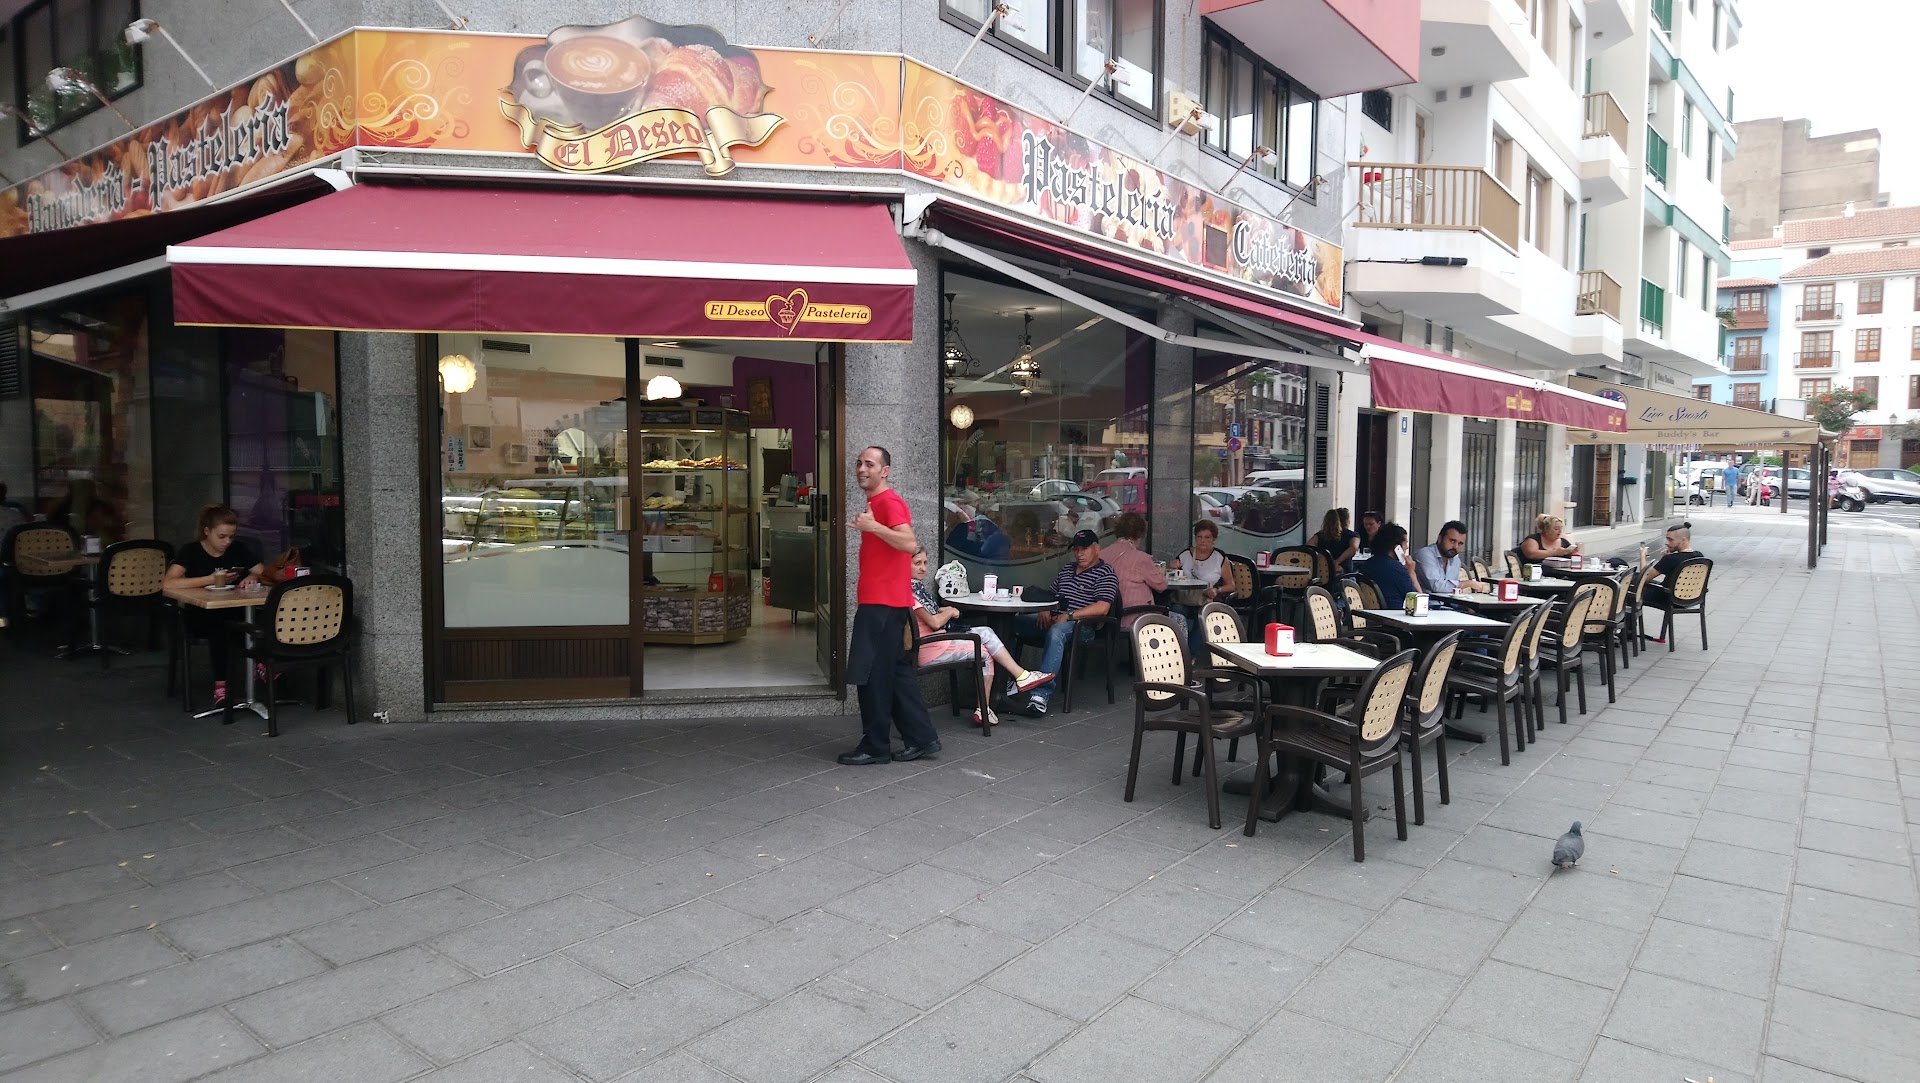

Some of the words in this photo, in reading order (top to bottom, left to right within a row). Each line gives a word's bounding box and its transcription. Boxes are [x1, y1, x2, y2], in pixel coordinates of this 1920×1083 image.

[148, 93, 290, 211] Pastelería
[554, 144, 593, 168] El
[602, 117, 704, 164] Deseo
[1022, 130, 1176, 240] Pastelería
[1233, 220, 1317, 286] Cafetería
[710, 304, 723, 316] El
[727, 305, 765, 317] Deseo
[807, 306, 868, 320] Pastelería
[1668, 406, 1710, 422] Sports
[1657, 430, 1697, 440] Buddy's
[1702, 430, 1720, 438] Bar
